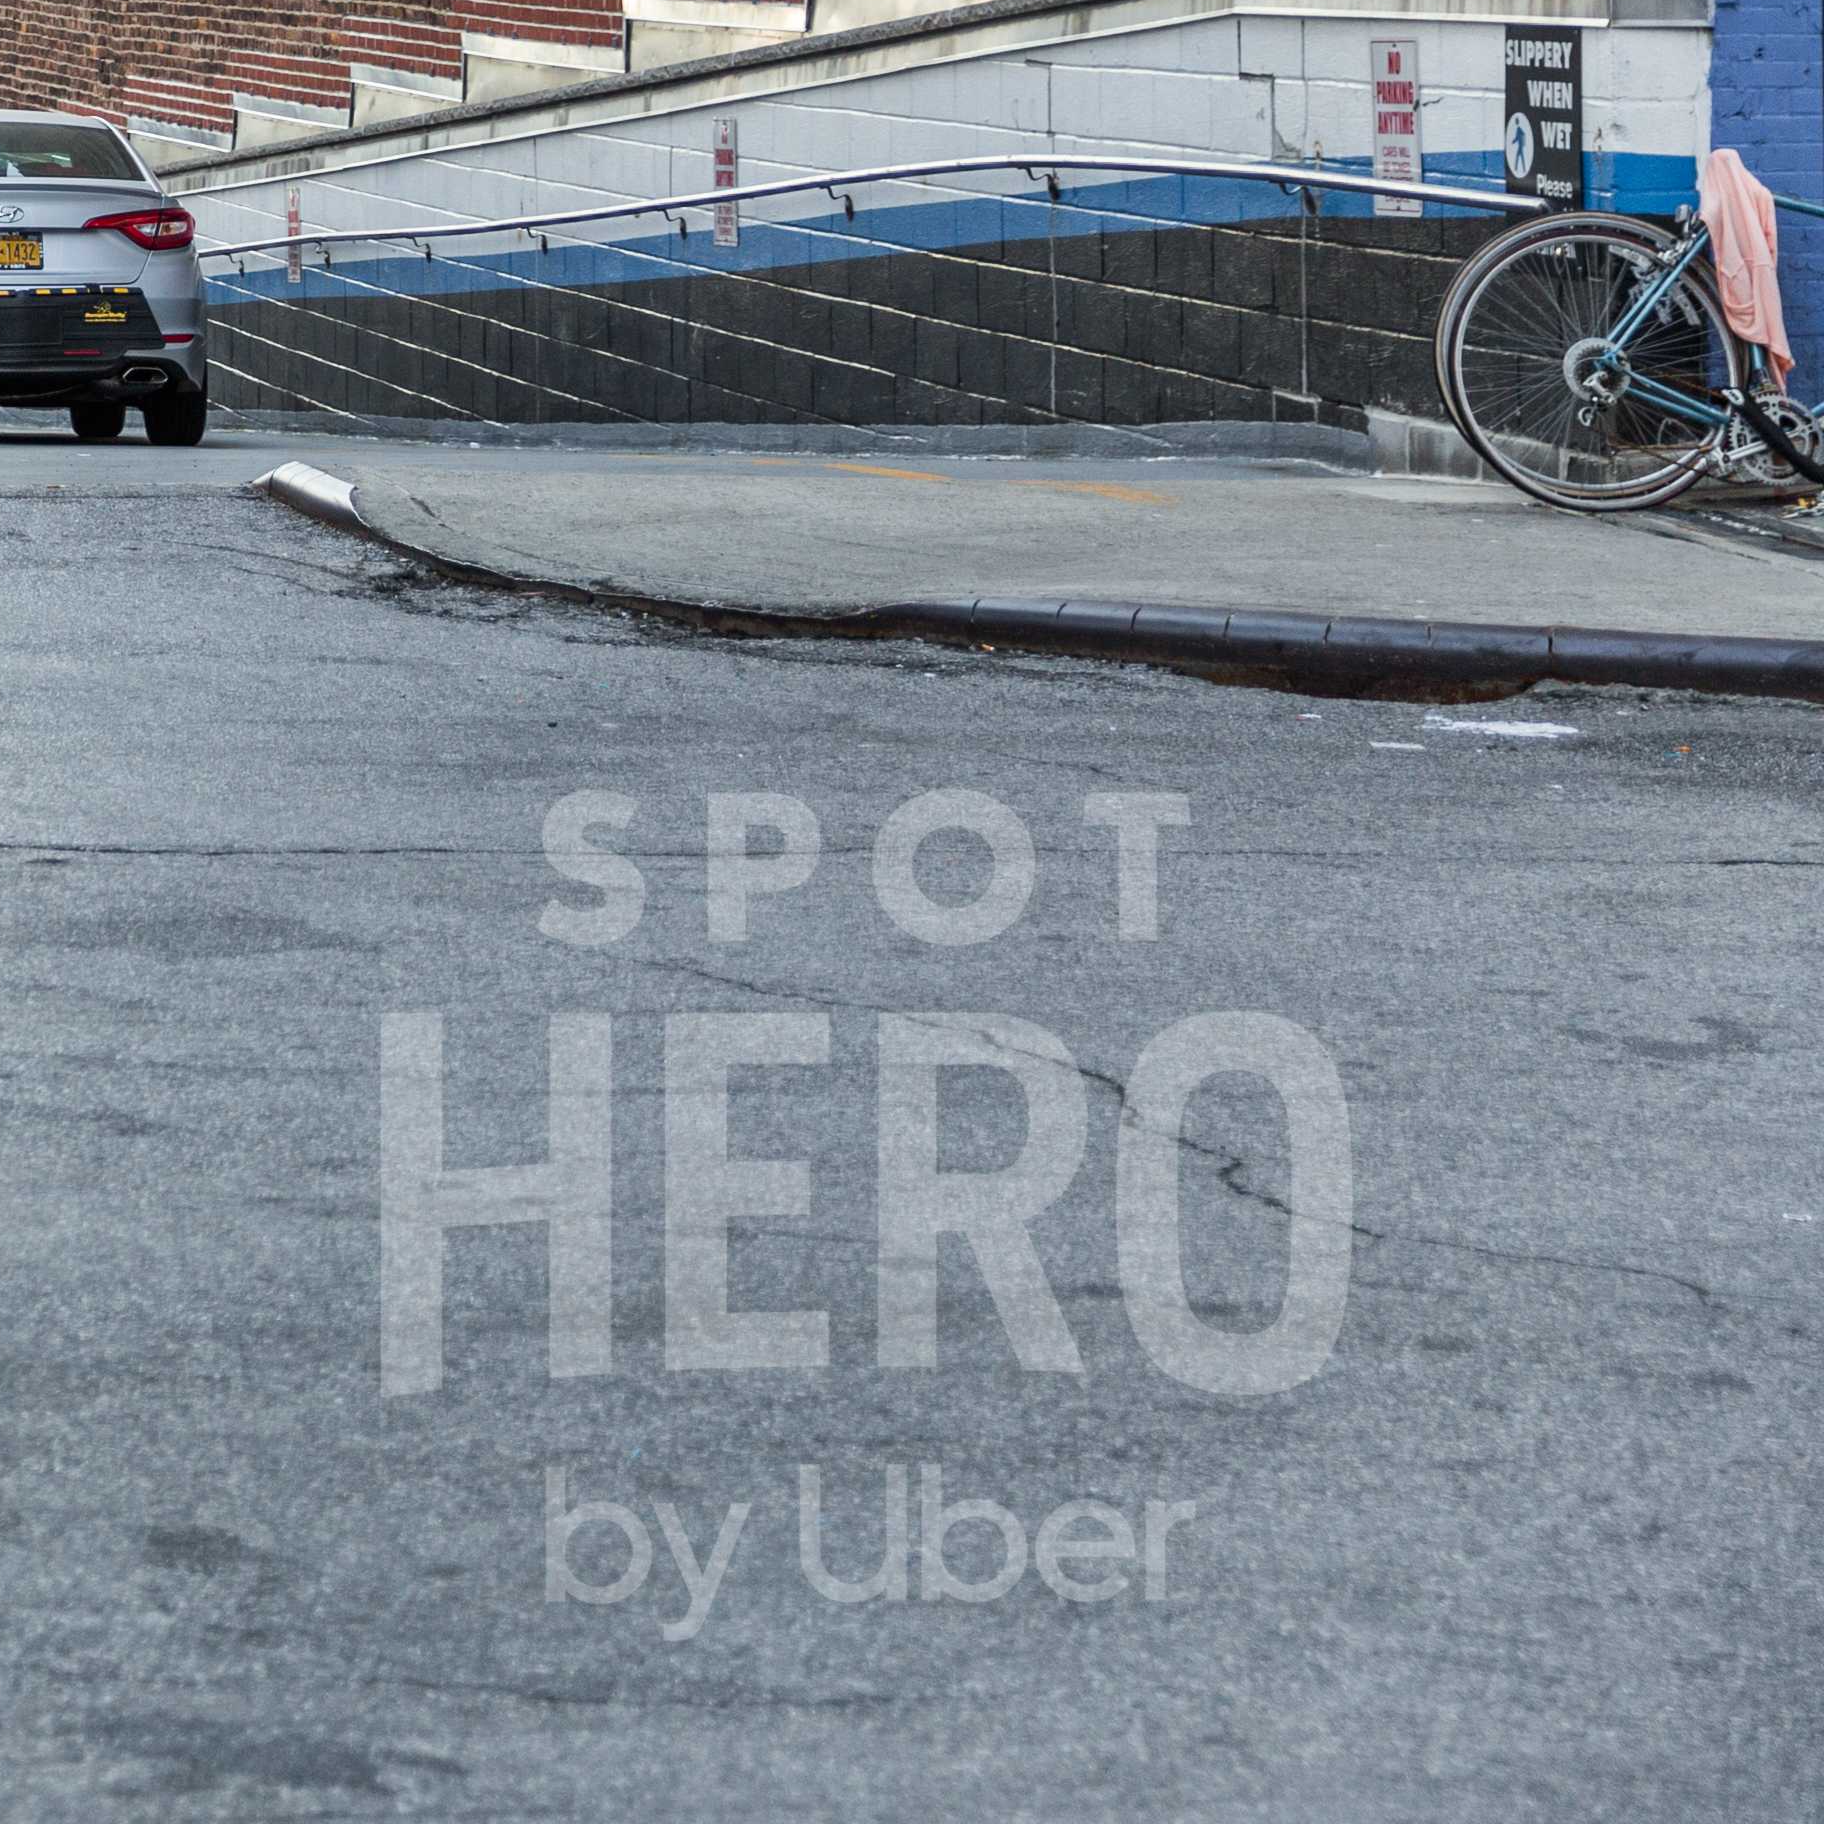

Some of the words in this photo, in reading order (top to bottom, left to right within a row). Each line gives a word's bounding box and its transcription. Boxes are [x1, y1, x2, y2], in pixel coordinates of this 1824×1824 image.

[1387, 51, 1401, 74] NO
[1505, 39, 1573, 69] SLIPPERY
[1376, 81, 1414, 105] PARKING
[1527, 80, 1573, 109] WHEN
[1378, 111, 1414, 135] ANYTIME
[1540, 121, 1573, 150] WET
[1536, 173, 1573, 198] Please
